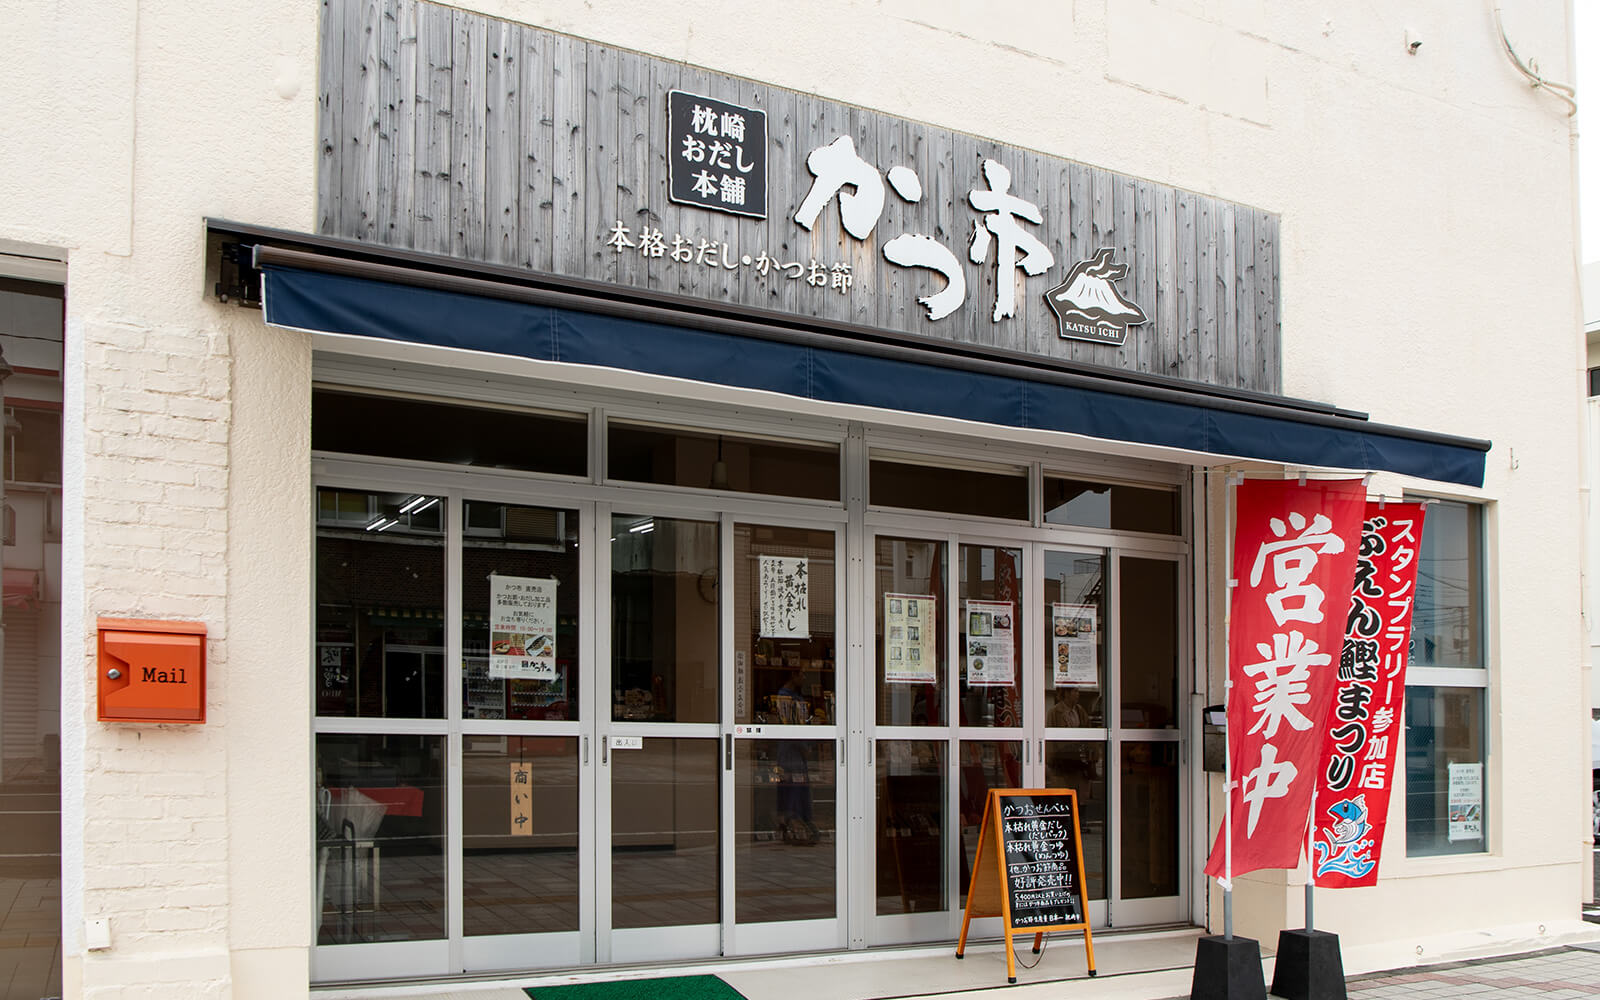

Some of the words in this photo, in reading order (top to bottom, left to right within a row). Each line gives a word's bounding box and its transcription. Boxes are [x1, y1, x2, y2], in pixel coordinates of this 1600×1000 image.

[691, 104, 746, 143] 枕崎
[682, 134, 754, 173] おだし
[691, 169, 746, 205] 本舗
[794, 135, 1055, 323] かつ市
[607, 220, 853, 294] 本格おだし・かつお節
[1065, 321, 1096, 335] KATSU
[1098, 327, 1119, 338] ICHI
[141, 667, 187, 684] Mail
[1242, 511, 1345, 840] 営業中
[514, 769, 529, 829] 商い中
[1004, 803, 1069, 816] かつおせんべい
